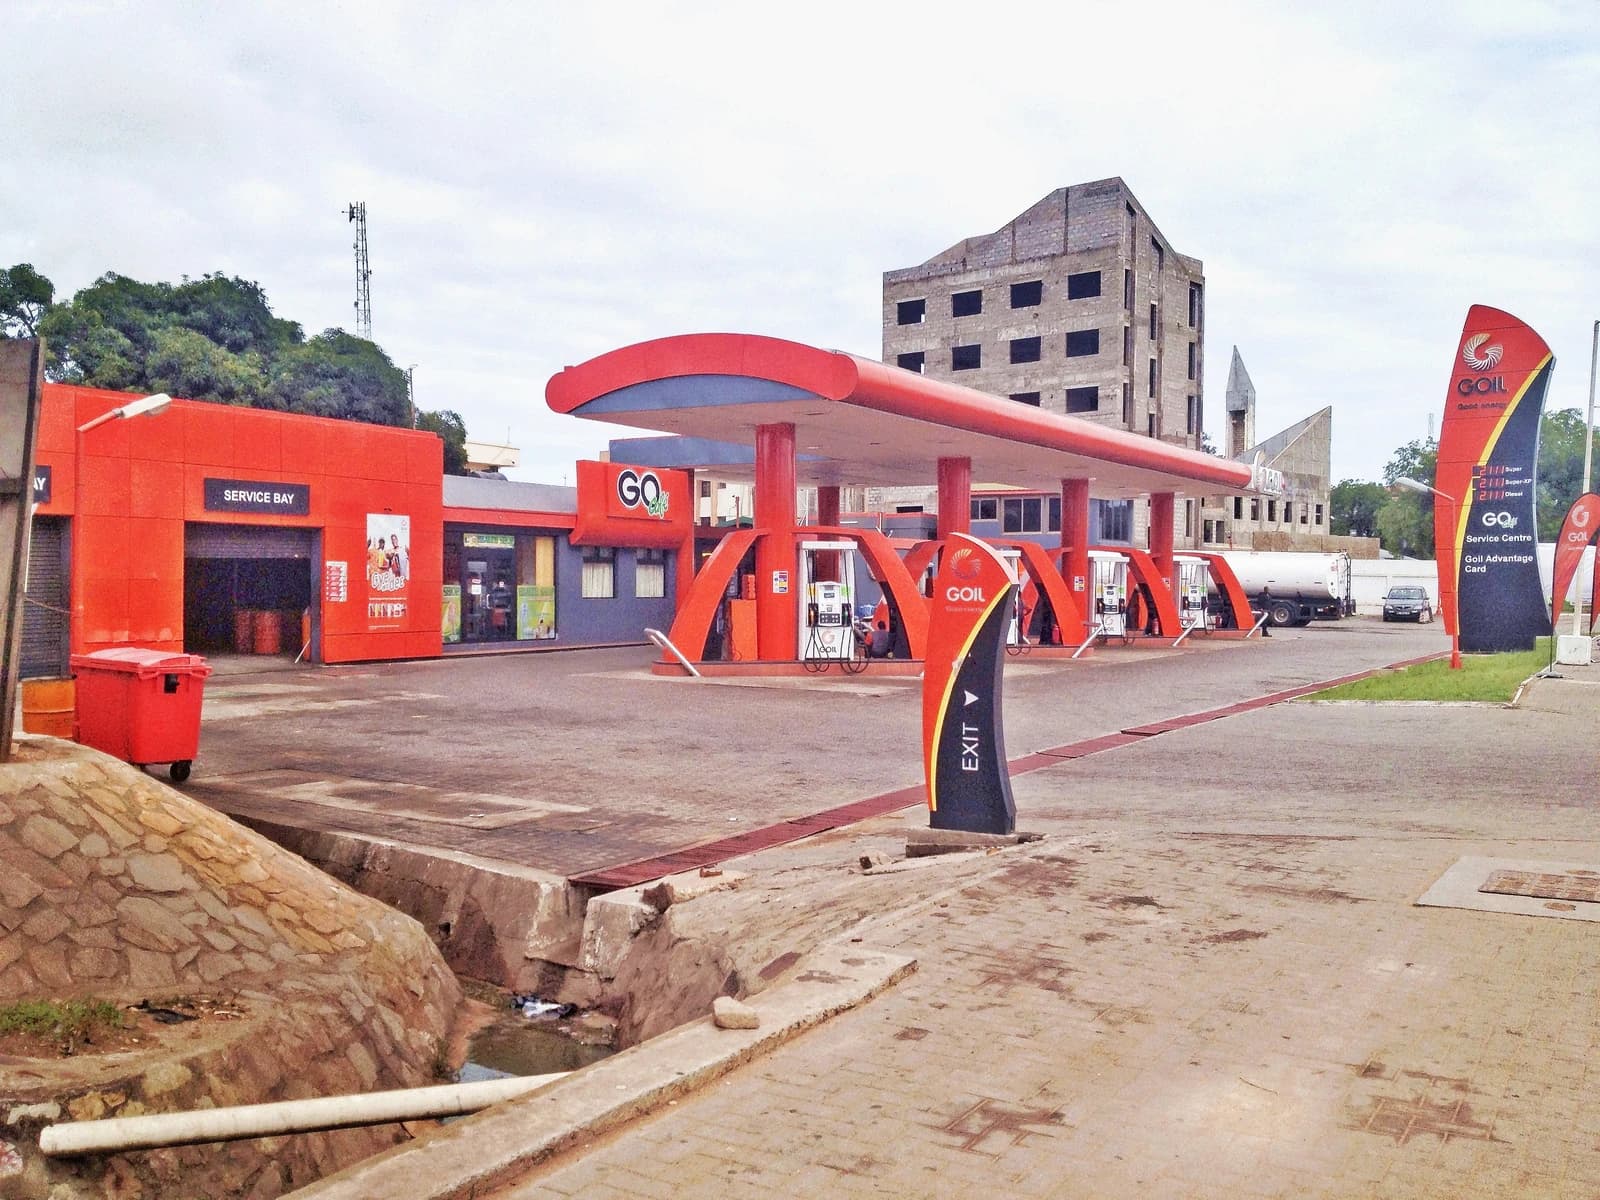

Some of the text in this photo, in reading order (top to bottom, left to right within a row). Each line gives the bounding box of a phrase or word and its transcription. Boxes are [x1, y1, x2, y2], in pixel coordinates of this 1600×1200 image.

[1458, 376, 1509, 397] GOIL
[33, 477, 46, 491] AY
[617, 469, 661, 510] GO
[223, 489, 295, 505] SERVICE BAY
[1482, 511, 1512, 526] GO
[1466, 534, 1532, 543] Service Centre
[1464, 554, 1534, 564] Goil Advantage
[1464, 565, 1487, 573] Card
[946, 586, 986, 602] GOIL
[961, 721, 979, 772] EXIT
